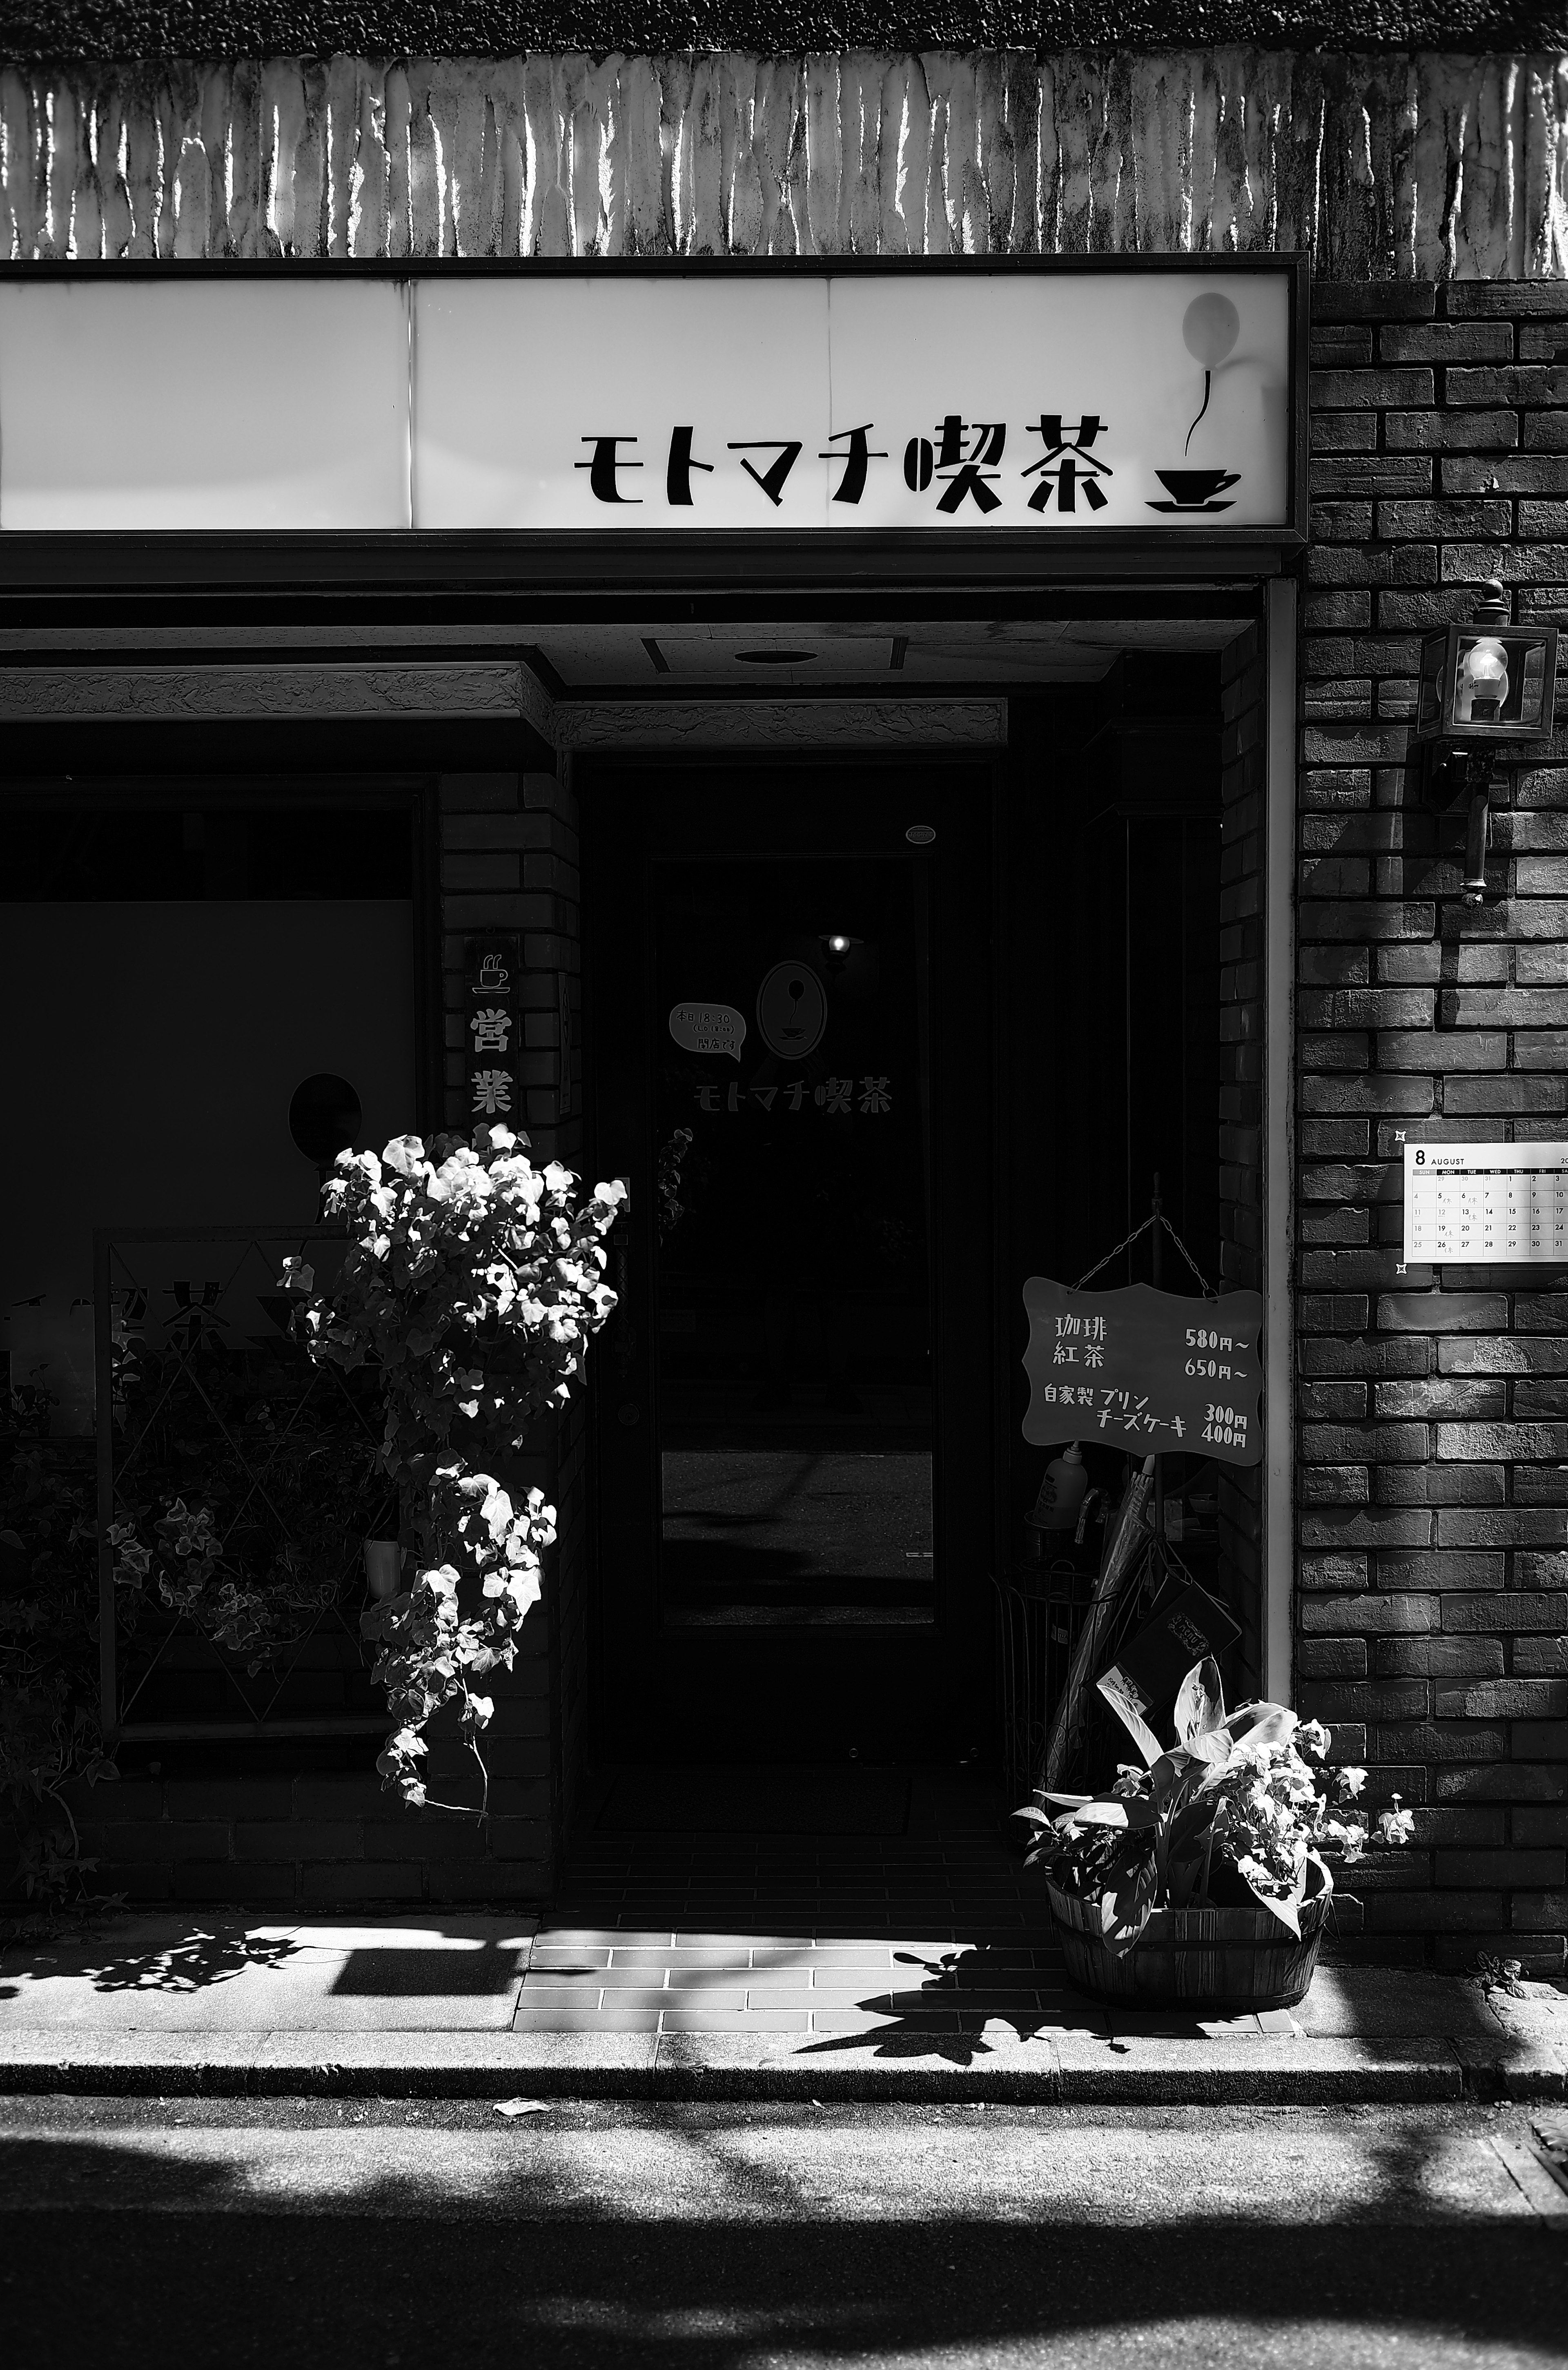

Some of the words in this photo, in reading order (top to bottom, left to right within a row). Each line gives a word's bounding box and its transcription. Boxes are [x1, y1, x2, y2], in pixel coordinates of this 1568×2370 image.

[574, 414, 1114, 514] モトマチ喫茶
[677, 1010, 693, 1021] 本日
[700, 1013, 730, 1023] 18:30
[698, 1038, 735, 1050] 閉店です
[694, 1076, 892, 1113] モトマチ喫茶
[1416, 1150, 1425, 1165] 8
[1055, 1313, 1107, 1341] 珈琲
[1052, 1341, 1105, 1368] 紅茶
[1044, 1383, 1094, 1406] 自家製
[1100, 1388, 1149, 1410] プリン
[1203, 1403, 1247, 1430] 300円
[1097, 1409, 1187, 1437] チーズケーキ
[1200, 1423, 1246, 1448] 400円
